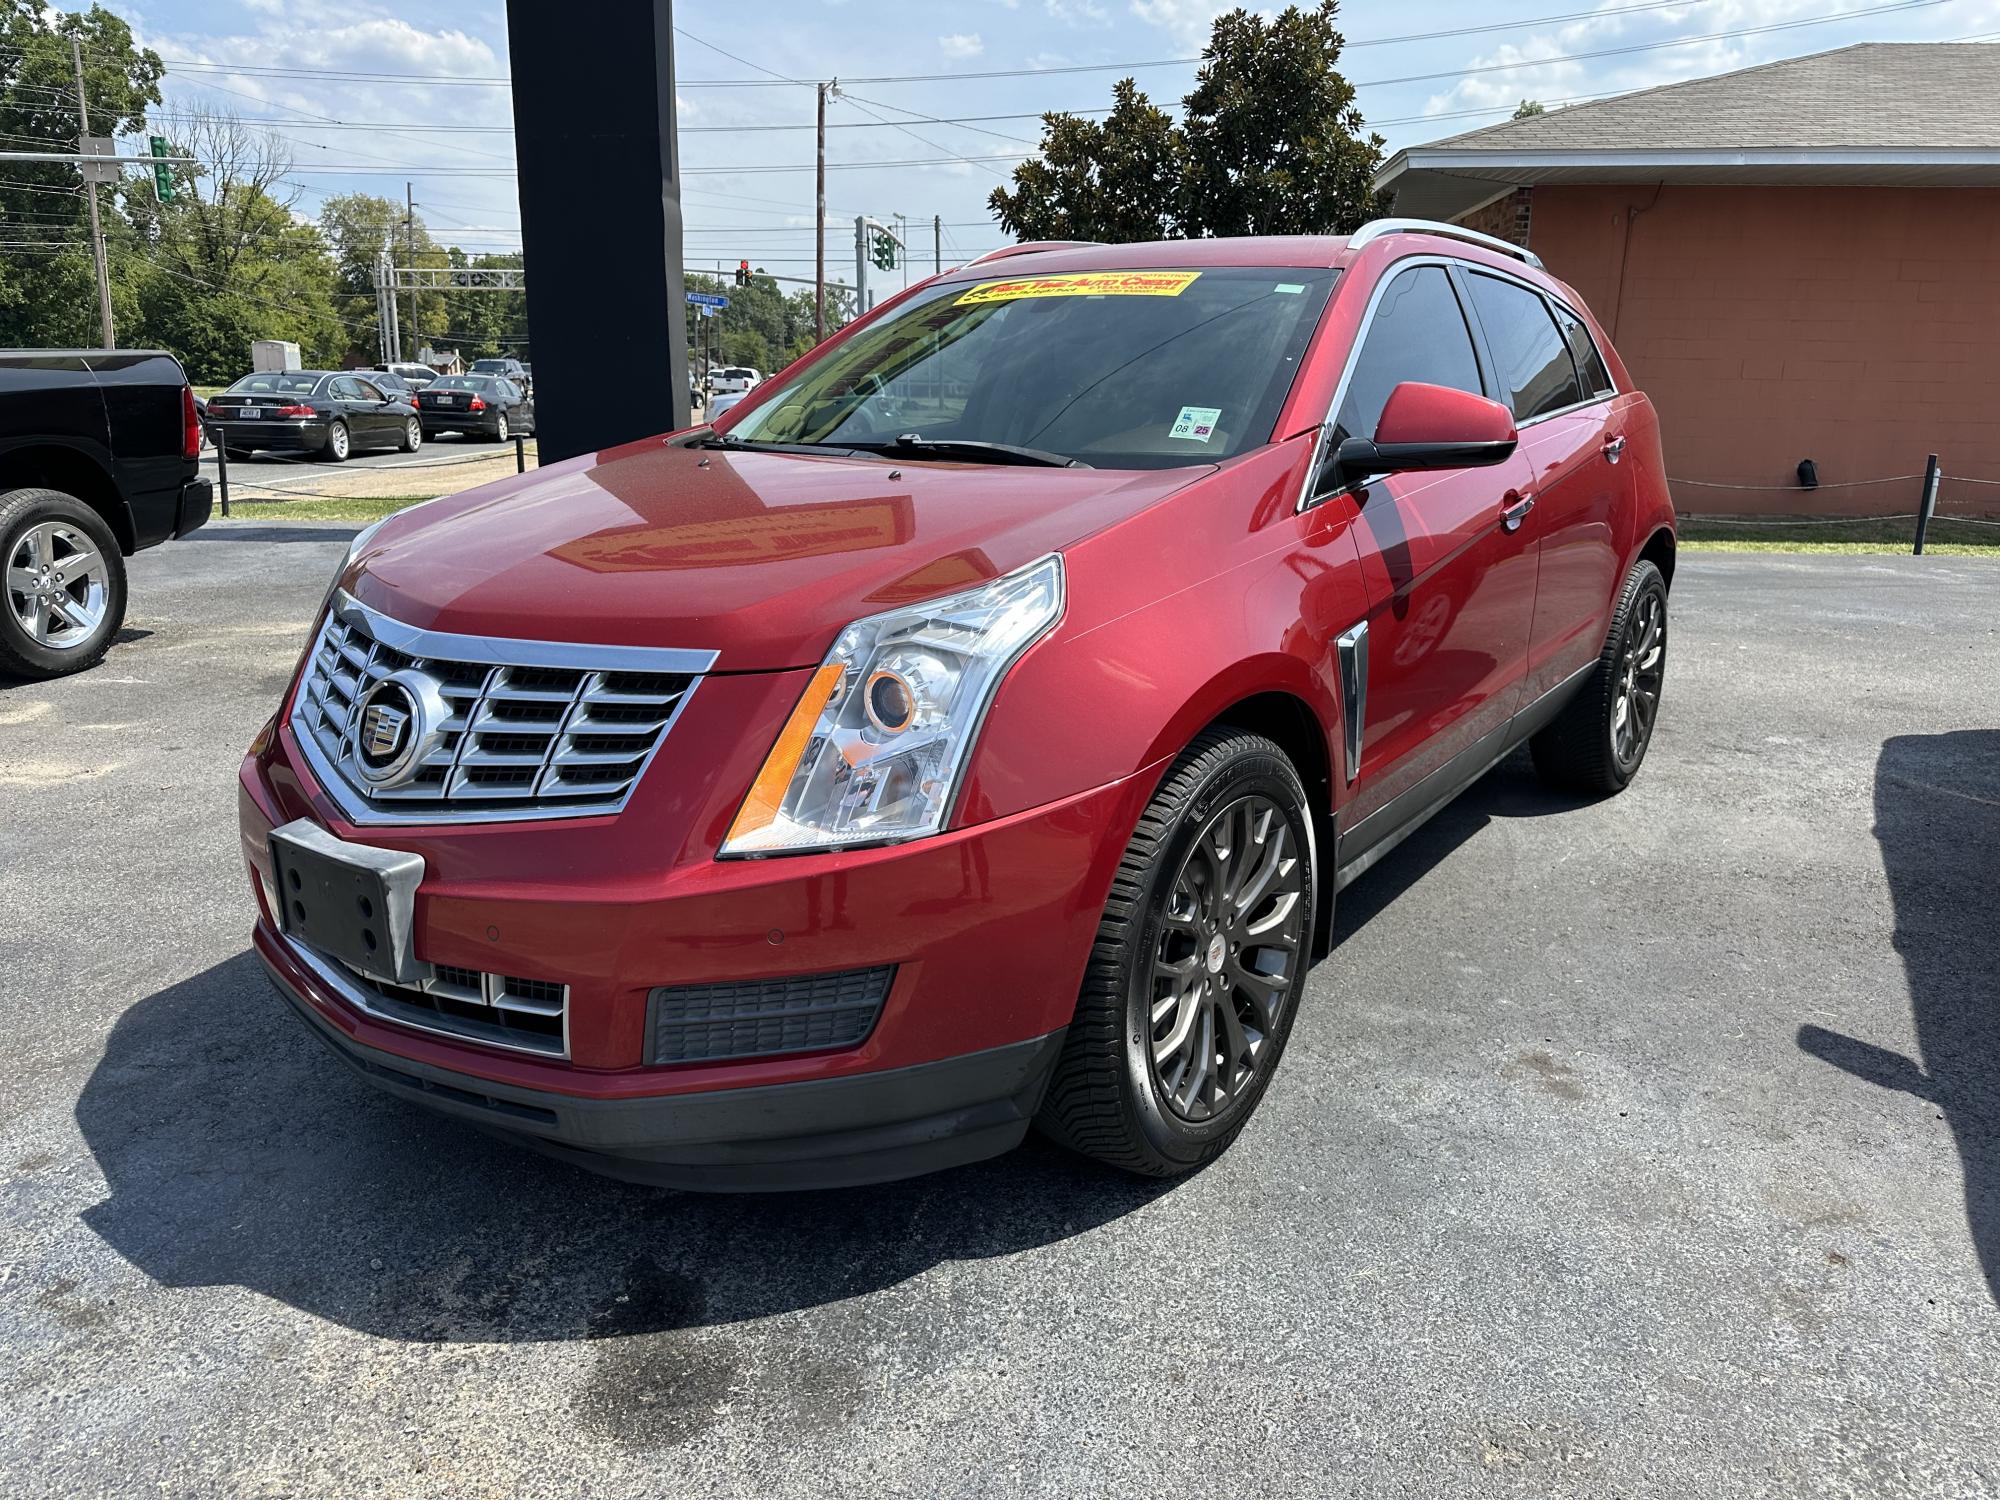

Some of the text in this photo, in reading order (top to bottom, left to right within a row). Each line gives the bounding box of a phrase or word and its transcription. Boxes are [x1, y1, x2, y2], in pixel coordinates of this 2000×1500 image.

[1070, 278, 1118, 287] AUTO
[1120, 277, 1186, 287] CREDIT
[687, 293, 719, 304] Washington
[1175, 424, 1189, 432] 08
[1195, 426, 1209, 434] 25
